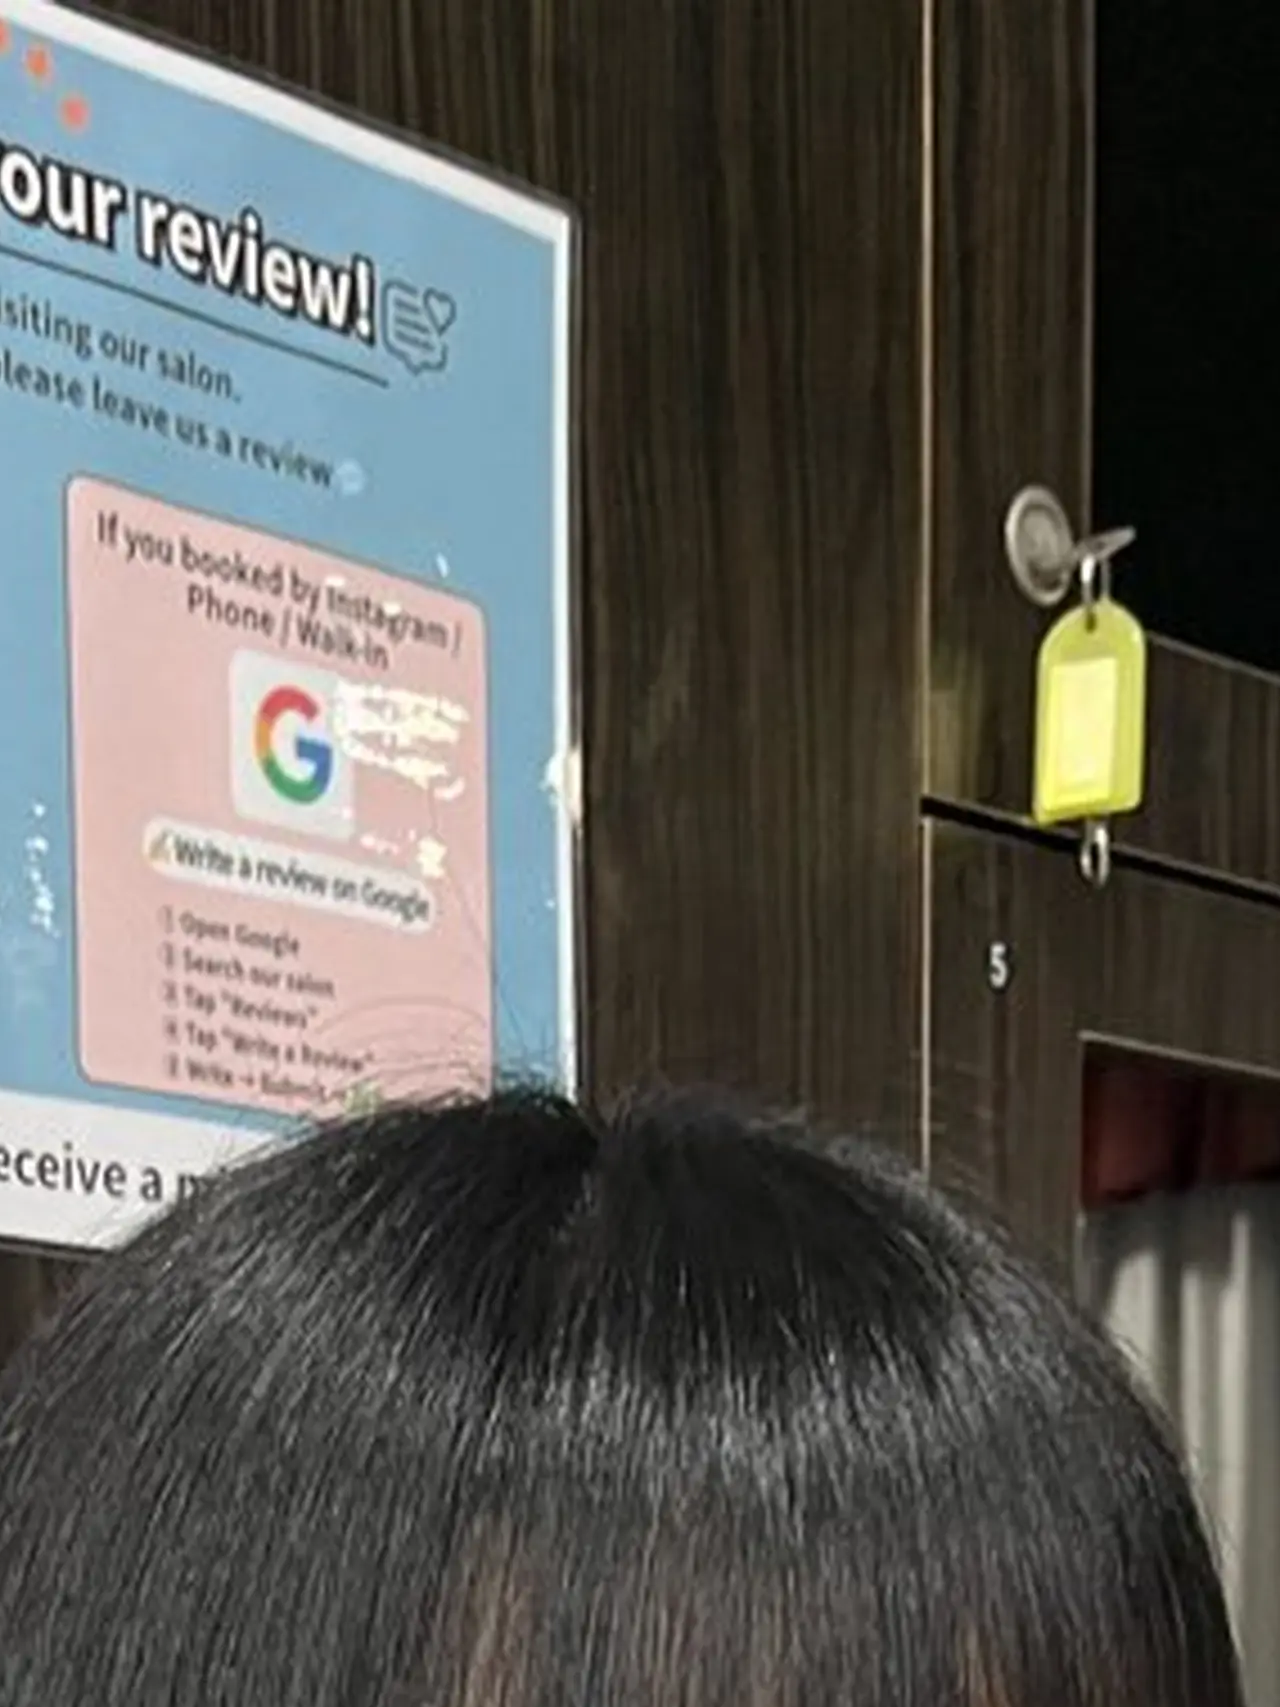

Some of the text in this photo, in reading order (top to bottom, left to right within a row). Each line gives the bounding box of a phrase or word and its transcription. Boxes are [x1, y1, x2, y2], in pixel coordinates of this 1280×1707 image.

[137, 190, 377, 346] review!
[99, 330, 153, 371] our
[158, 346, 242, 402] salon.
[93, 379, 170, 438] leave
[176, 417, 208, 450] us
[213, 427, 233, 456] a
[238, 433, 332, 488] review
[97, 511, 118, 546] If
[124, 527, 173, 566] you
[180, 536, 283, 598] booked
[290, 568, 321, 614] by
[326, 583, 449, 651] Instagram
[187, 583, 276, 637] Phone
[297, 612, 390, 671] Walk-in
[255, 686, 333, 806] G
[173, 835, 430, 925] Write a review on Google
[990, 942, 1007, 987] 5
[140, 1167, 163, 1203] a
